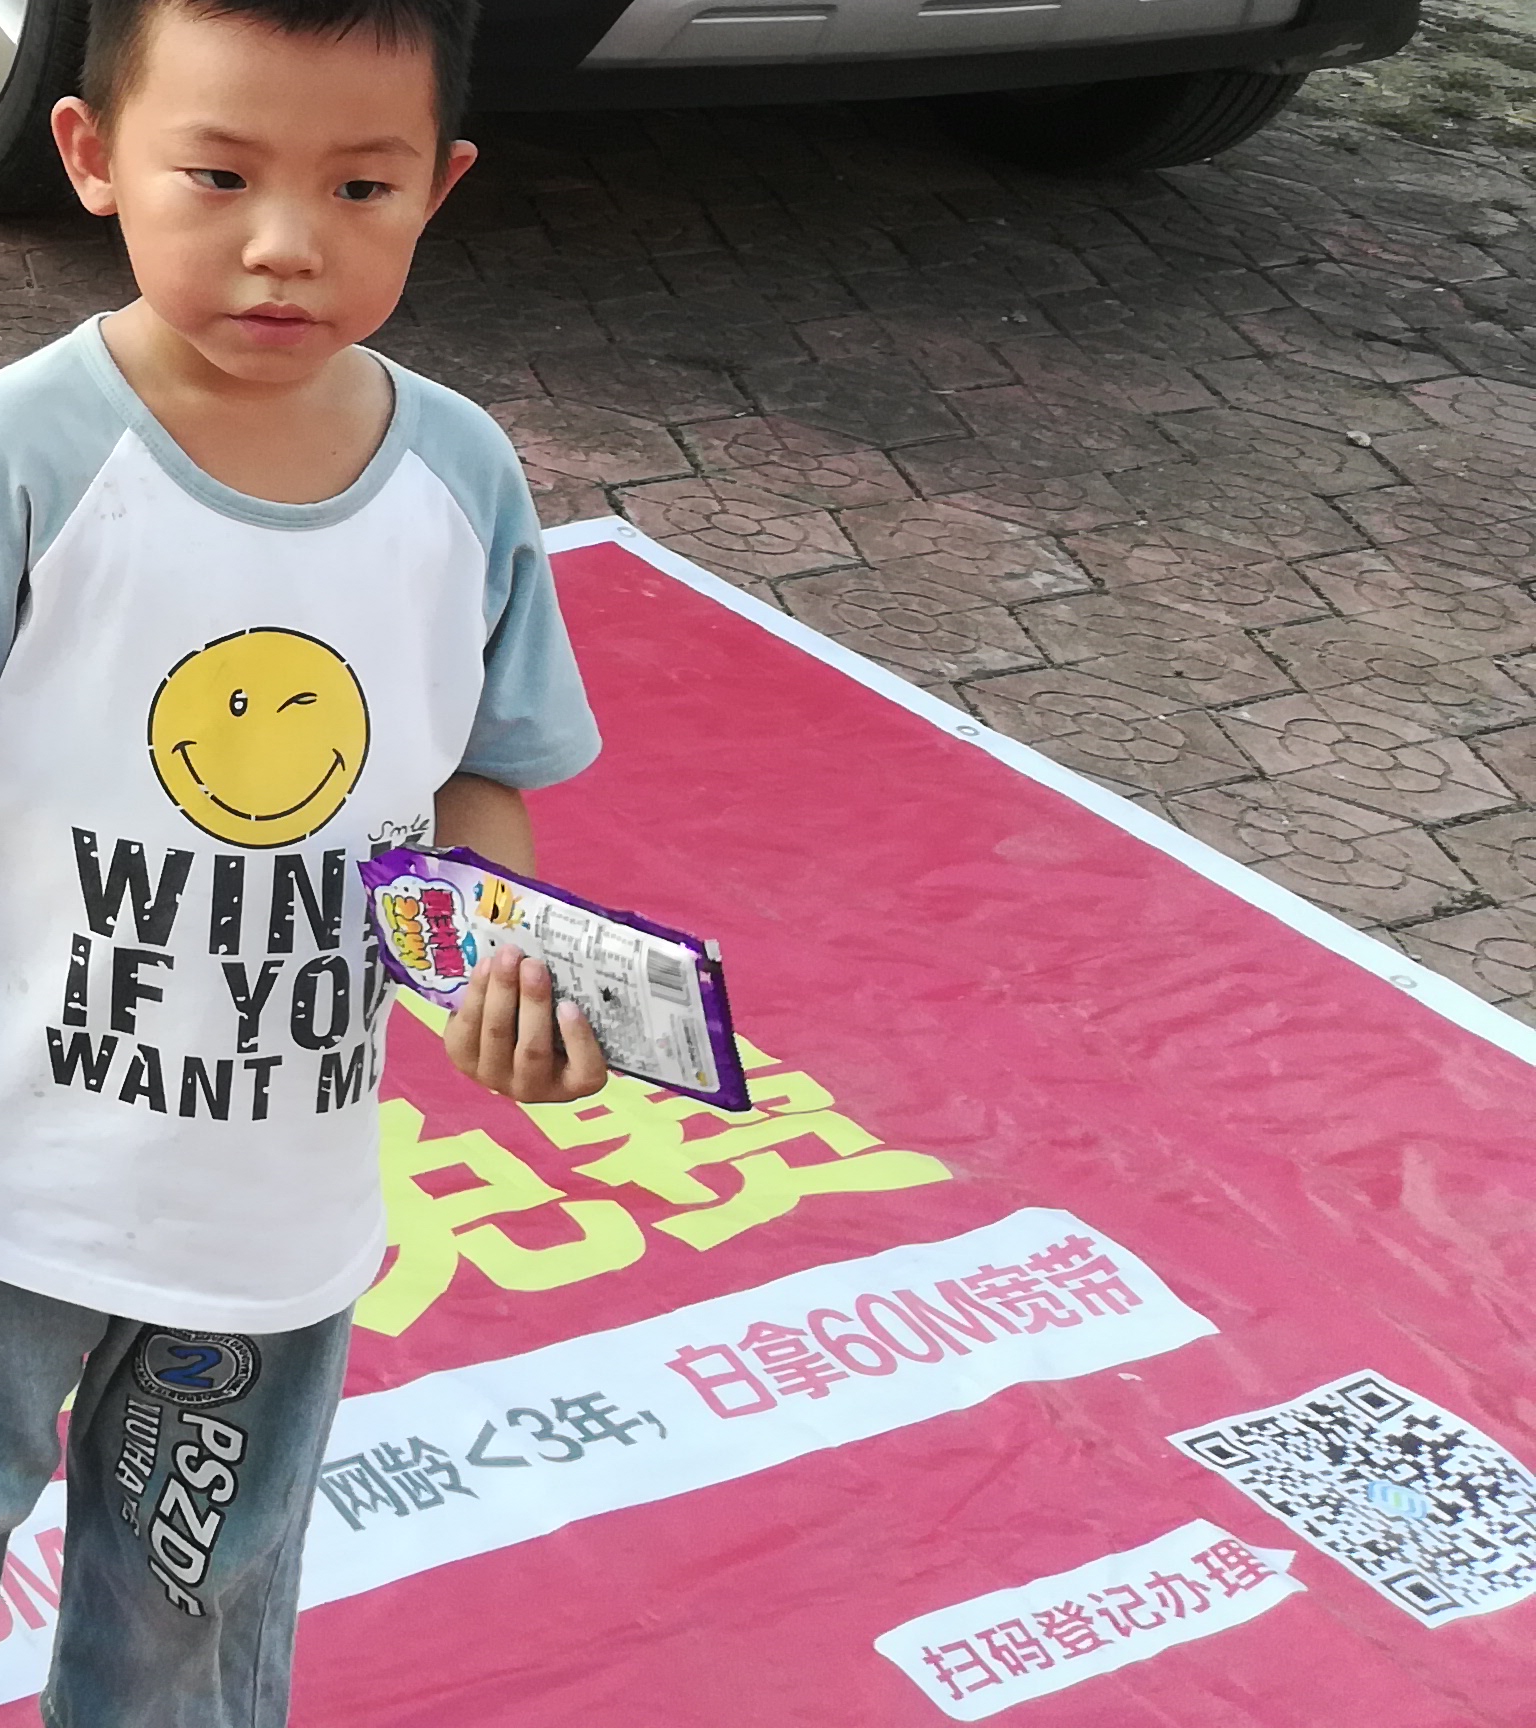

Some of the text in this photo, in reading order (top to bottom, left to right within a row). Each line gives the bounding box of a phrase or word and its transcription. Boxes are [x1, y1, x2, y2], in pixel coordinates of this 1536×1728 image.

[61, 933, 175, 1037] IF
[45, 1027, 283, 1122] WANT
[353, 1059, 952, 1338] 免费
[922, 1538, 1273, 1703] 扫码登记办理
